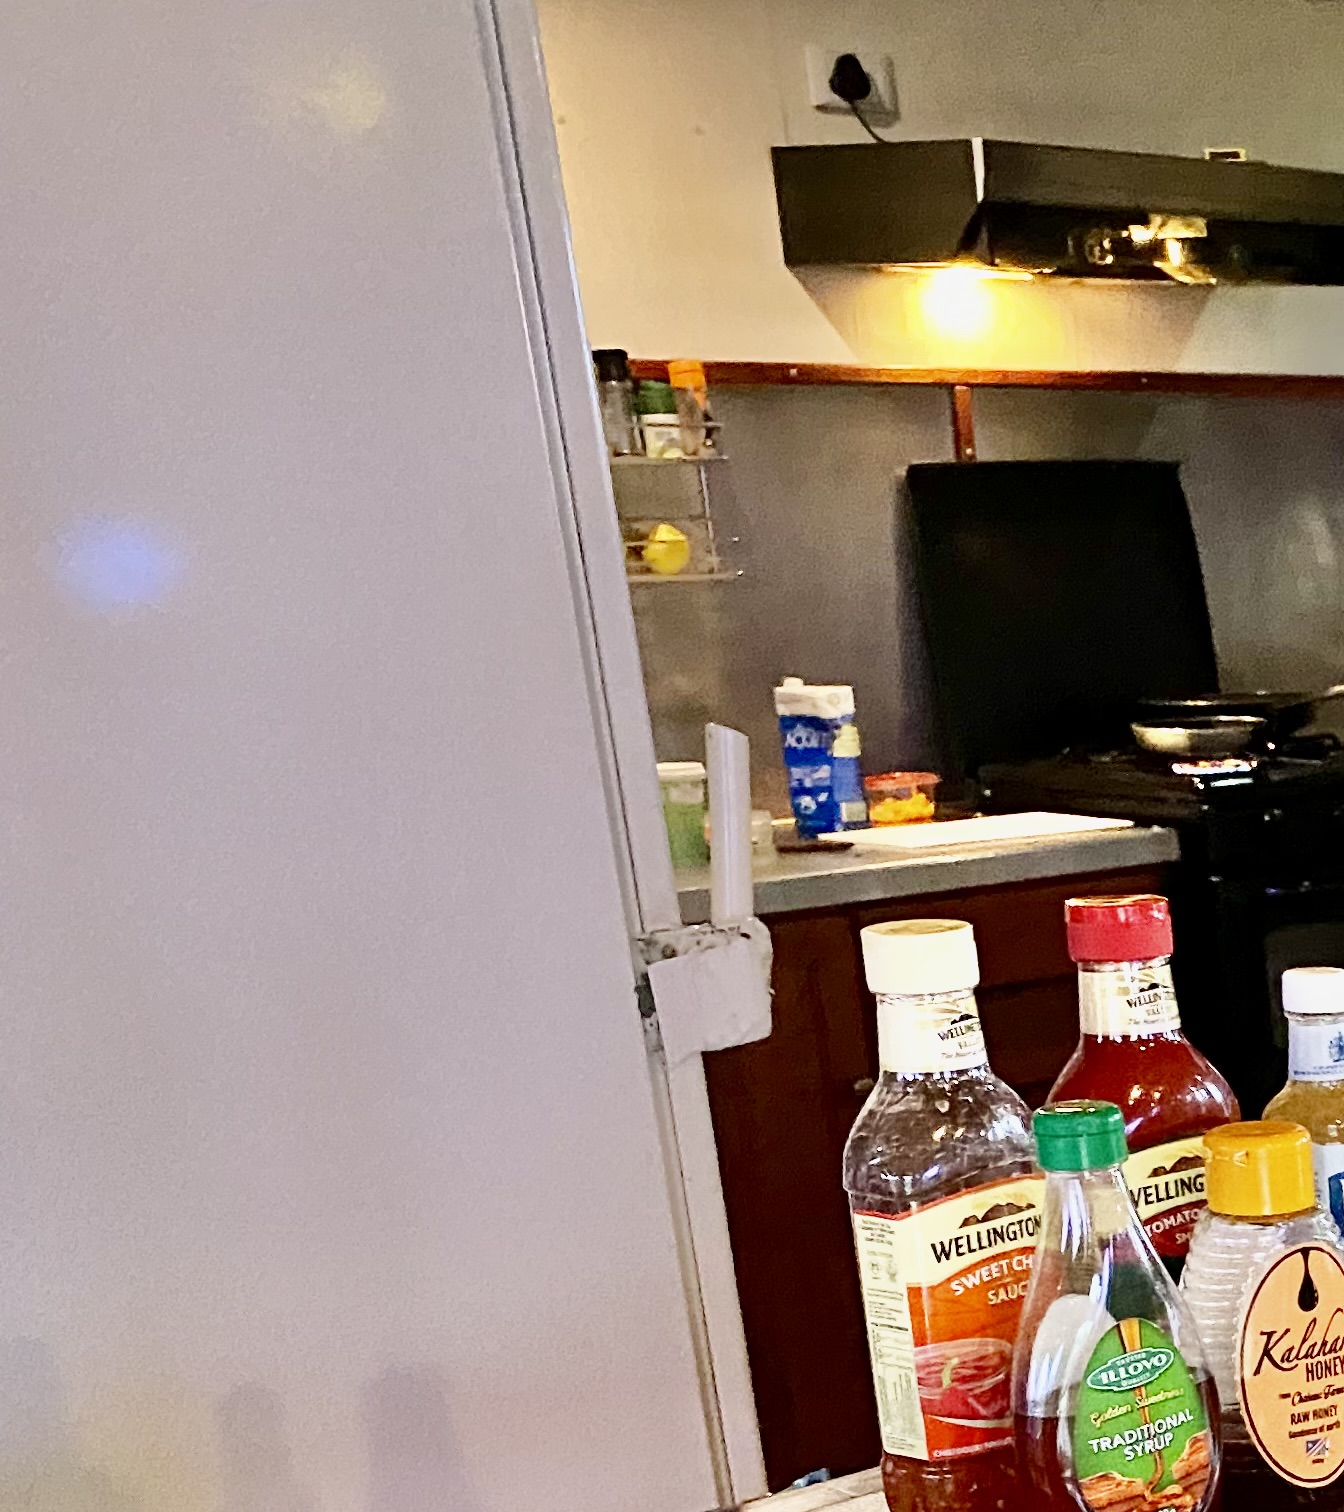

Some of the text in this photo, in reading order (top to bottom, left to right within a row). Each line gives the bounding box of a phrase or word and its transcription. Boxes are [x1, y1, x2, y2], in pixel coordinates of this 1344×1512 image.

[1129, 1173, 1206, 1210] WELLING
[949, 1259, 1010, 1297] SWEET
[987, 1280, 1030, 1306] SAUC
[1100, 1353, 1168, 1385] ILLOVO
[1089, 1403, 1132, 1429] Golden
[1290, 1404, 1338, 1426] RAW HONEY
[1087, 1408, 1195, 1454] TRADITIONAL
[1123, 1431, 1175, 1462] SYRUP
